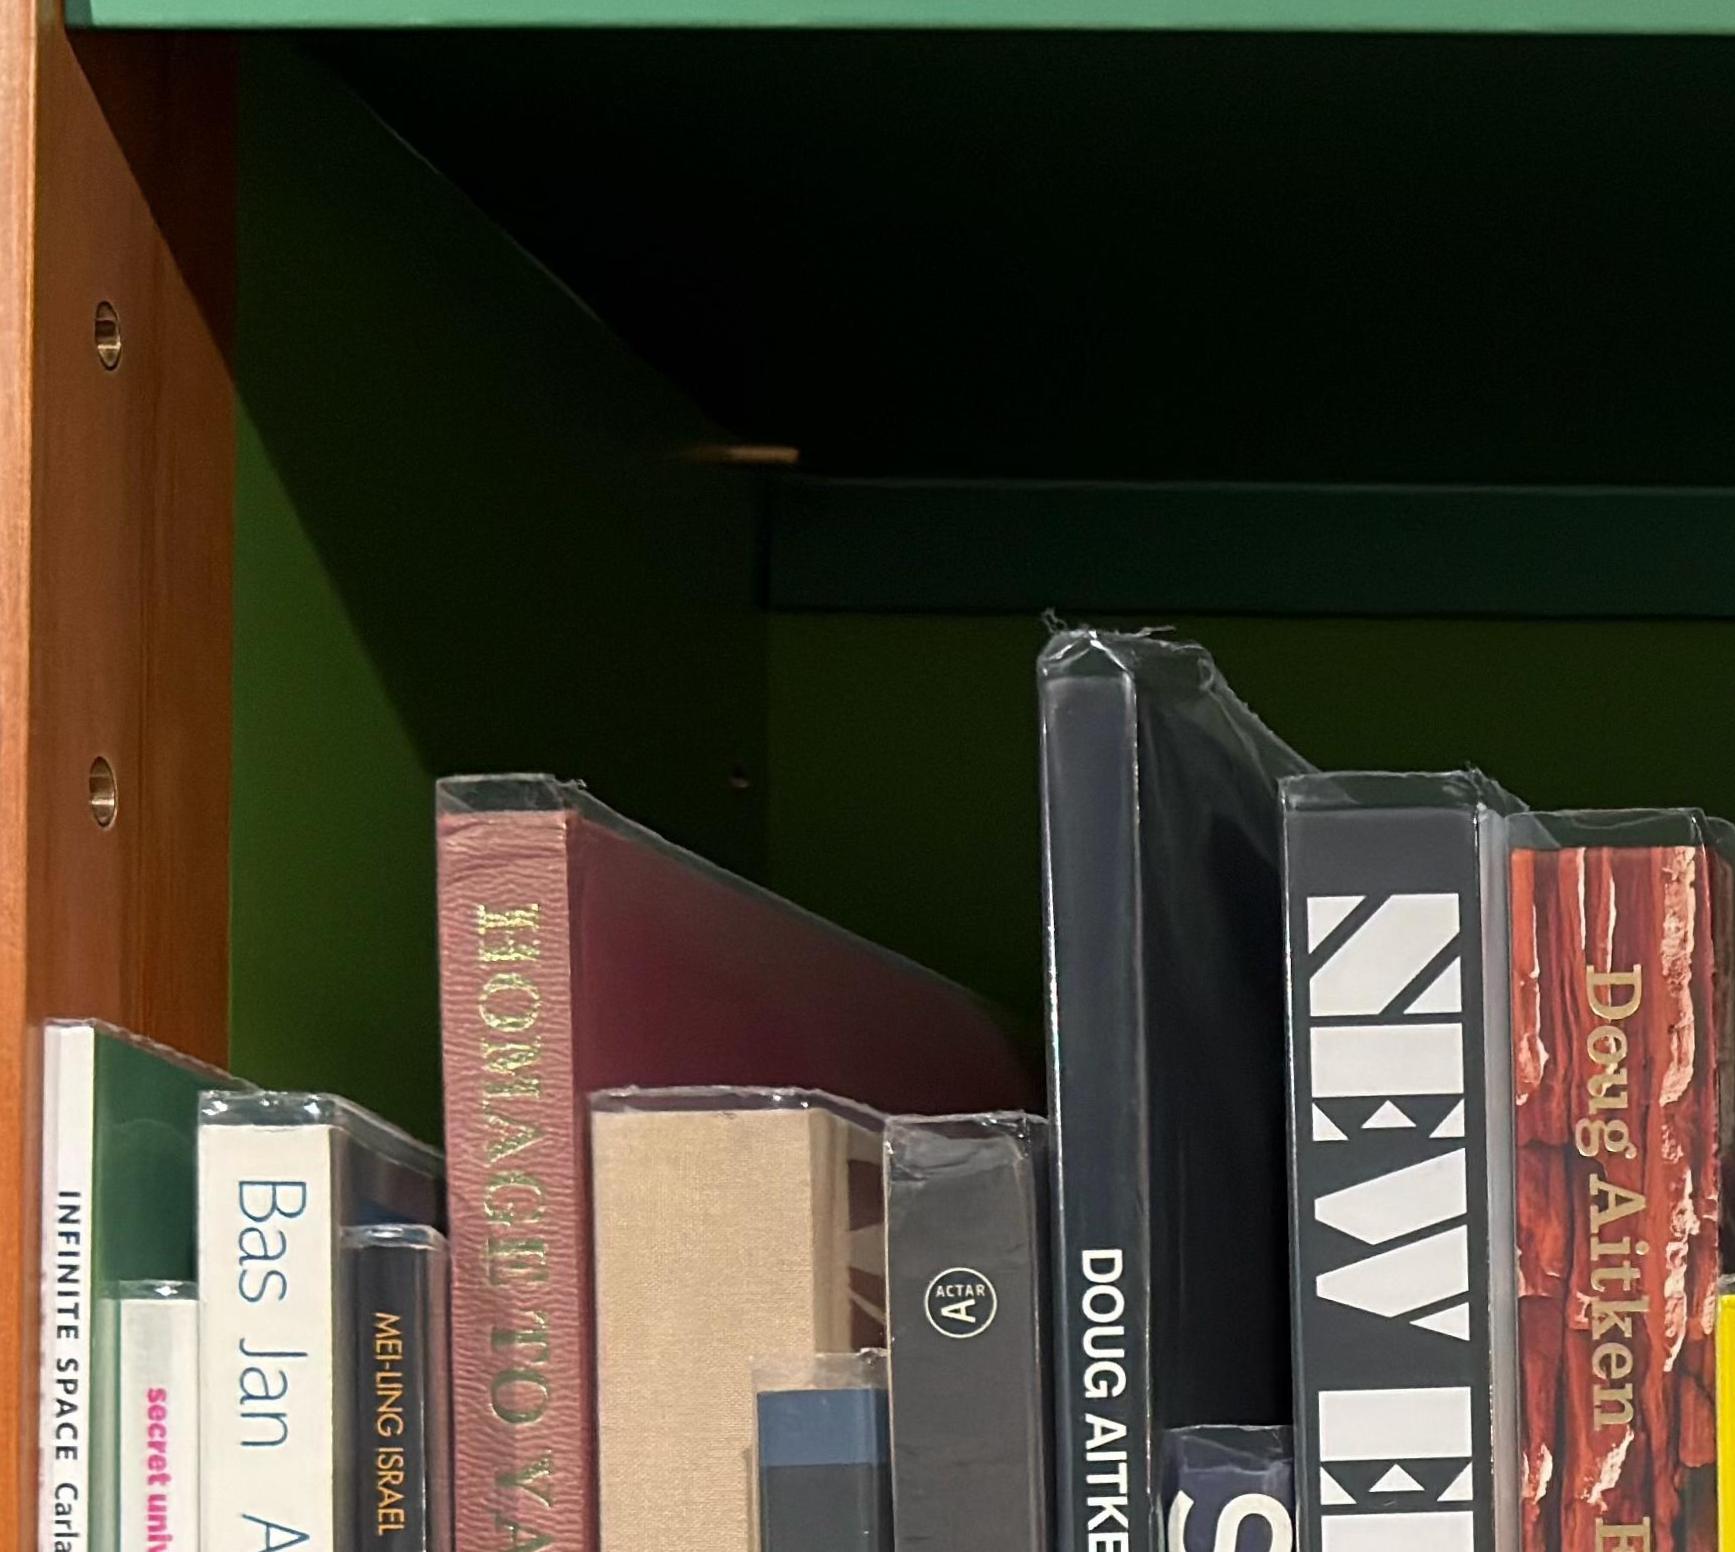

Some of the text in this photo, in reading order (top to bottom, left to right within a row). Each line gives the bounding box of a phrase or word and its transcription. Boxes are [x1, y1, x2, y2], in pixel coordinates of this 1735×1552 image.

[477, 903, 550, 1290] HOMAGE
[1307, 892, 1471, 1342] NEW
[1574, 963, 1643, 1160] Doug
[56, 1191, 81, 1340] INFINITE
[238, 1180, 307, 1303] Bas
[1589, 1173, 1651, 1432] Aitken
[238, 1337, 309, 1447] Jan
[490, 1310, 550, 1426] TO
[1081, 1248, 1127, 1399] DOUG
[55, 1358, 79, 1460] SPACE
[146, 1387, 174, 1484] secret
[375, 1312, 405, 1536] MEI-LING ISRAEL
